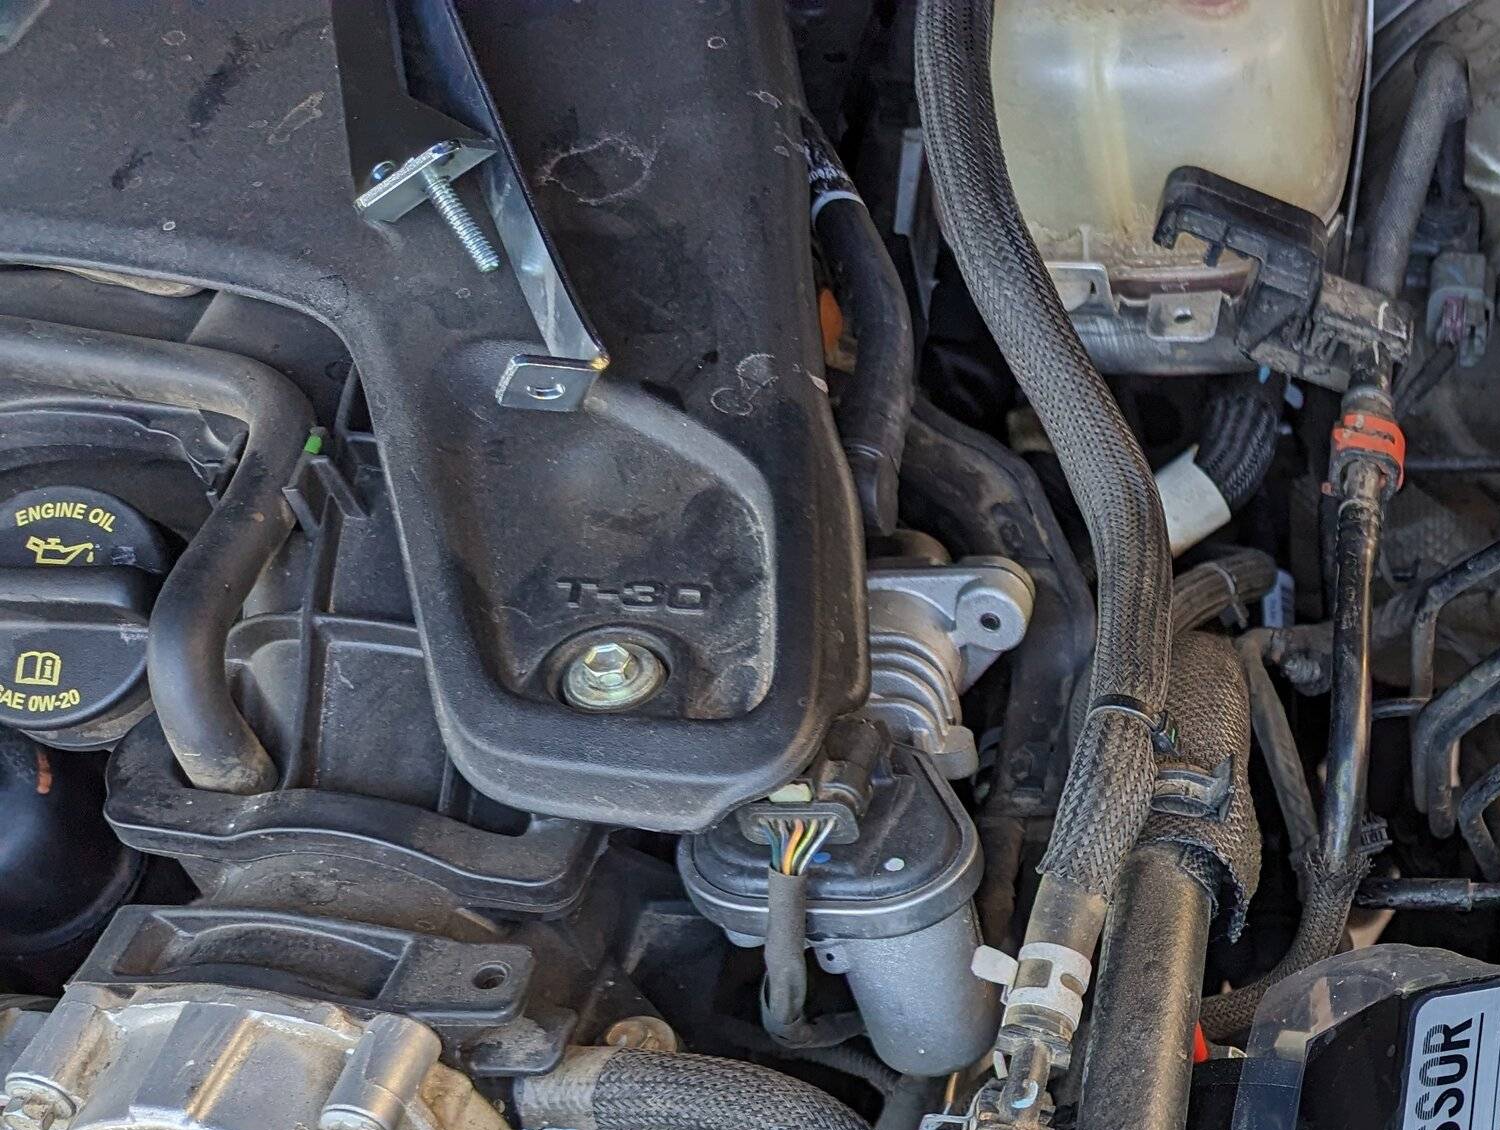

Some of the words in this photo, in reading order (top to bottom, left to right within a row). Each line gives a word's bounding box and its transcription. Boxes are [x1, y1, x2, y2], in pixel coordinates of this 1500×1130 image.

[15, 502, 87, 526] ENGINE
[88, 508, 116, 532] OIL
[28, 689, 80, 712] 0W-20
